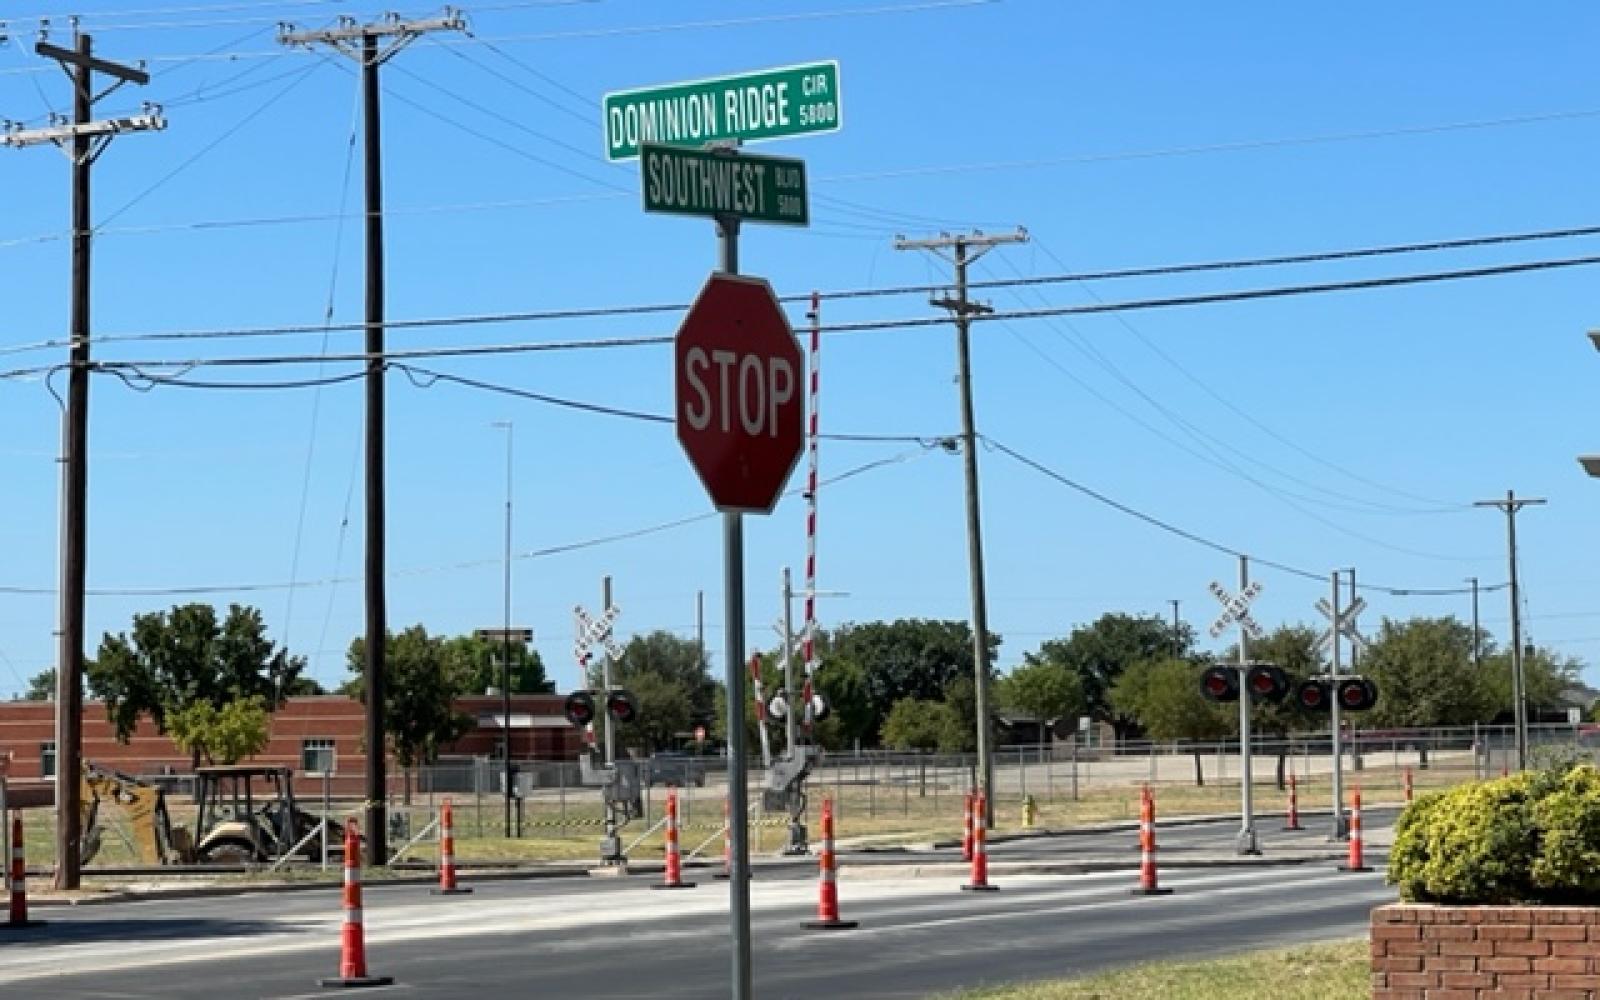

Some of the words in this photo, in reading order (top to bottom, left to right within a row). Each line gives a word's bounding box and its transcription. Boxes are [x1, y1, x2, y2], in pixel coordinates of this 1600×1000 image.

[610, 92, 717, 148] DOMINION
[725, 82, 790, 133] RIDGE
[802, 74, 828, 96] CIR
[649, 152, 766, 213] SOUTHWEST
[685, 347, 793, 437] STOP
